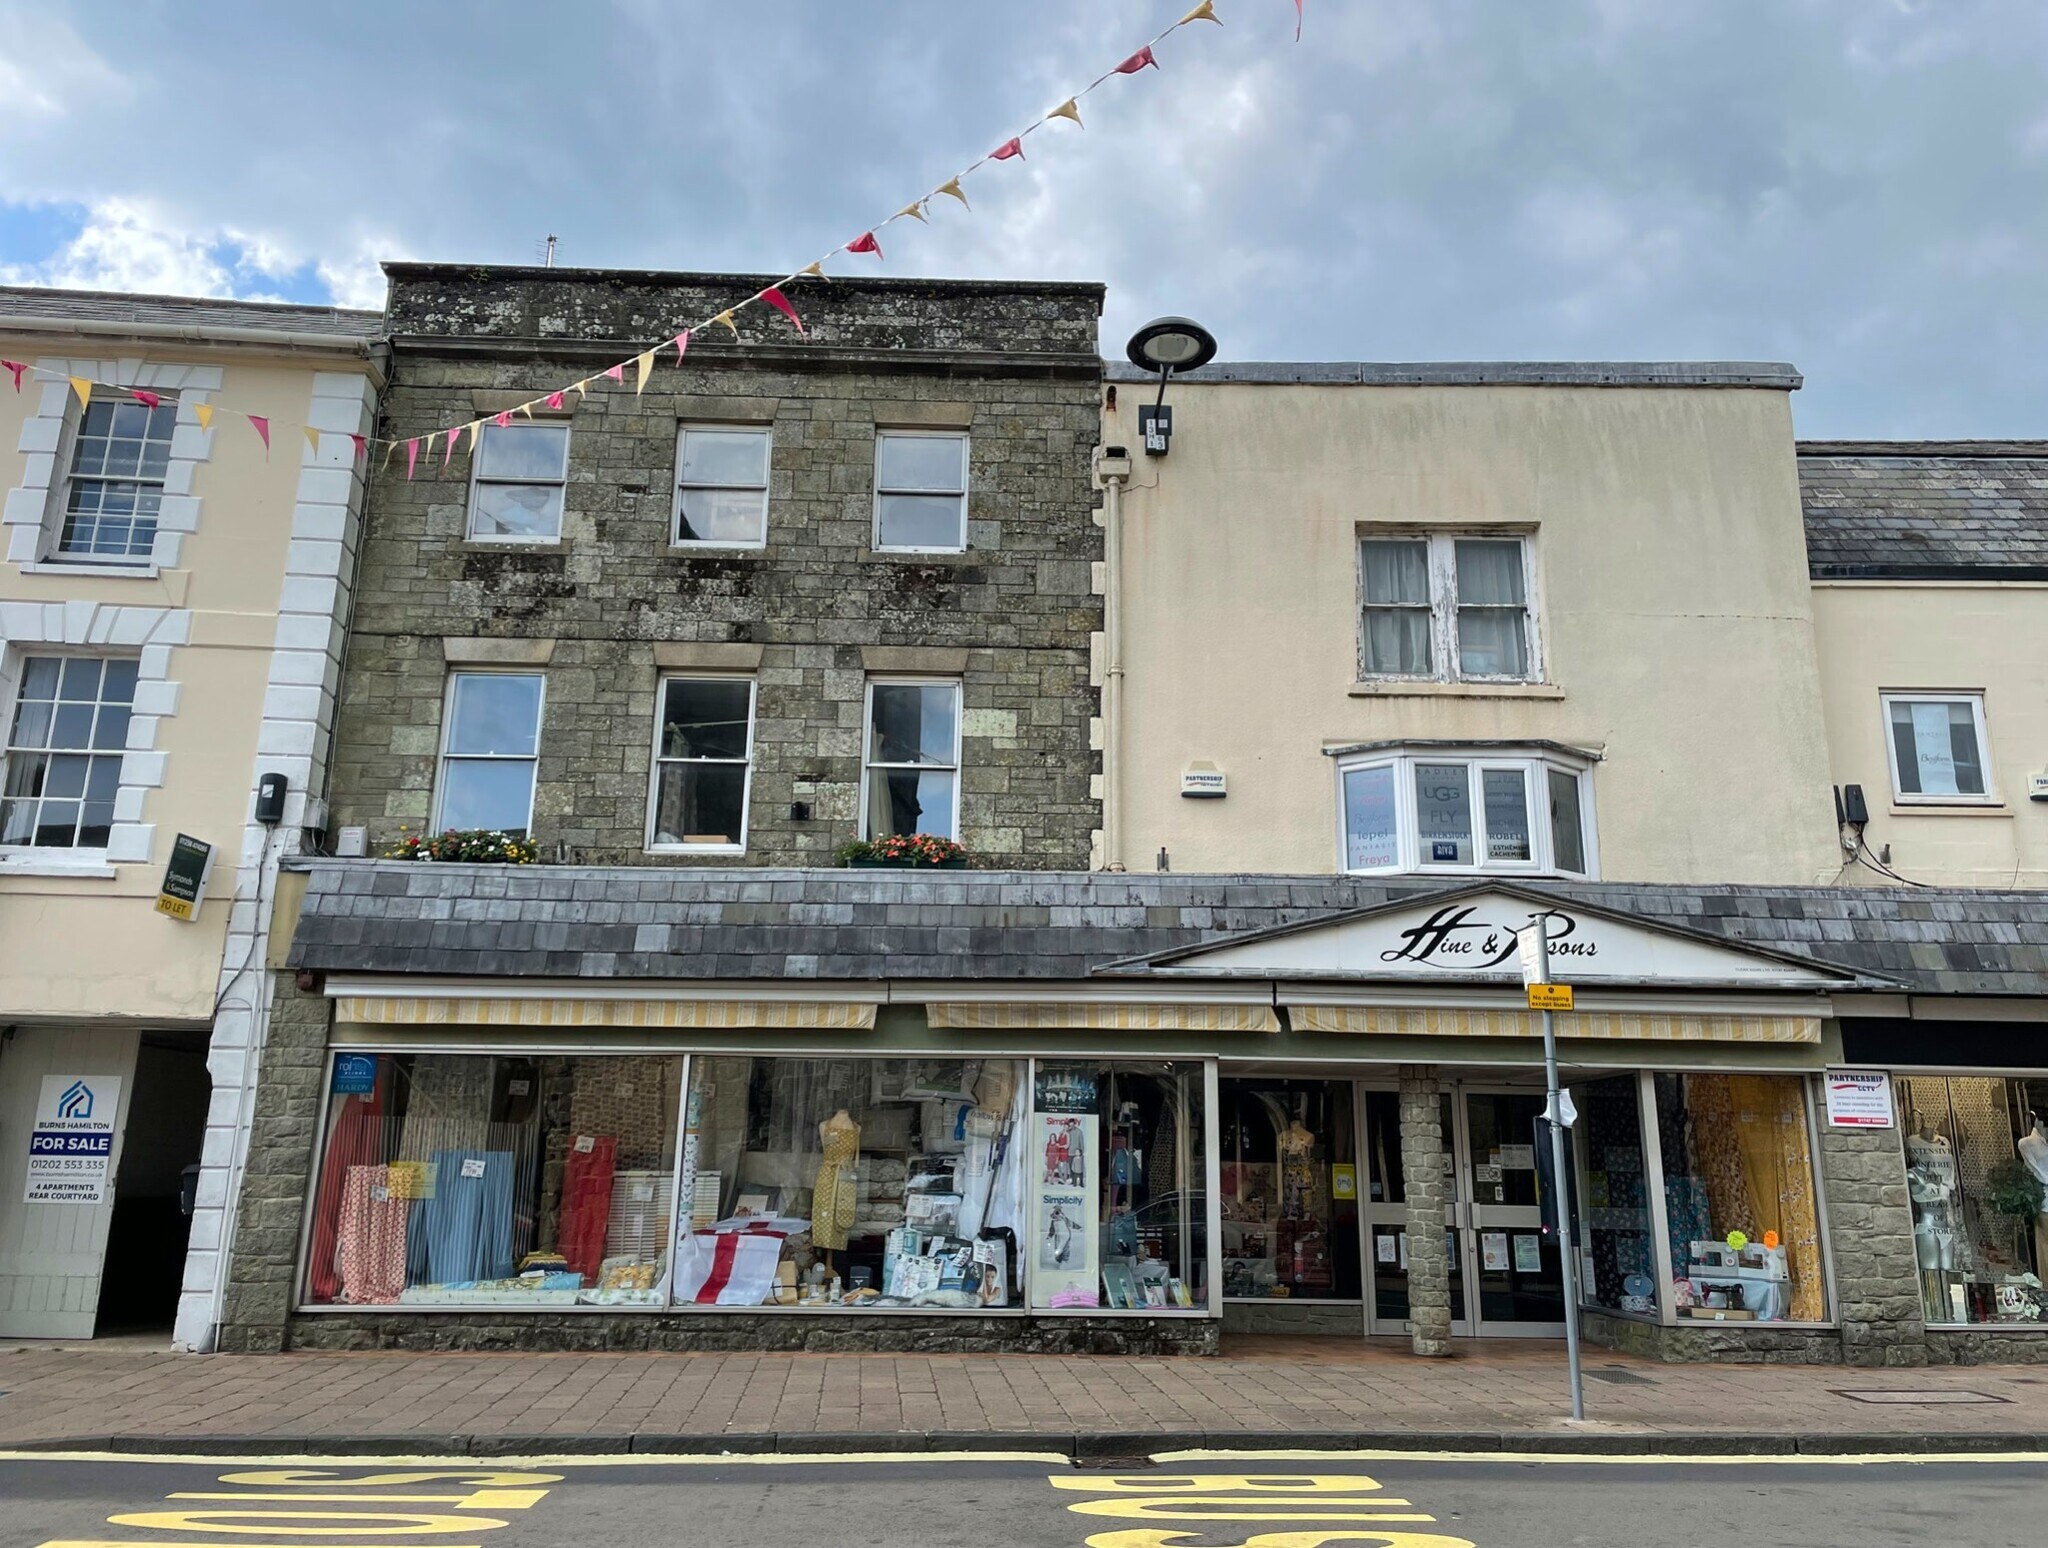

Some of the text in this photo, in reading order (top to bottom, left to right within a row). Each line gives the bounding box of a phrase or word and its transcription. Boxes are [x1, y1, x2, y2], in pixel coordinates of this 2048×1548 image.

[1424, 786, 1460, 802] UGG
[1430, 810, 1457, 824] FLY
[1420, 831, 1469, 840] BIRKENSTOCK
[1359, 854, 1391, 865] Freya
[161, 899, 188, 915] TO LET
[1381, 904, 1491, 962] Hine
[1481, 933, 1499, 955] &
[1828, 1074, 1884, 1082] PARTNERSHIP
[67, 1122, 110, 1130] HAMILTON
[32, 1137, 109, 1151] FOR SALE
[1908, 1147, 1952, 1155] XTENSIVE
[31, 1160, 105, 1170] 01202 553 335
[42, 1183, 95, 1191] APARTMENTS
[1930, 1187, 1941, 1195] AT
[51, 1192, 99, 1200] COURTYARD
[1043, 1195, 1083, 1206] Simplicity
